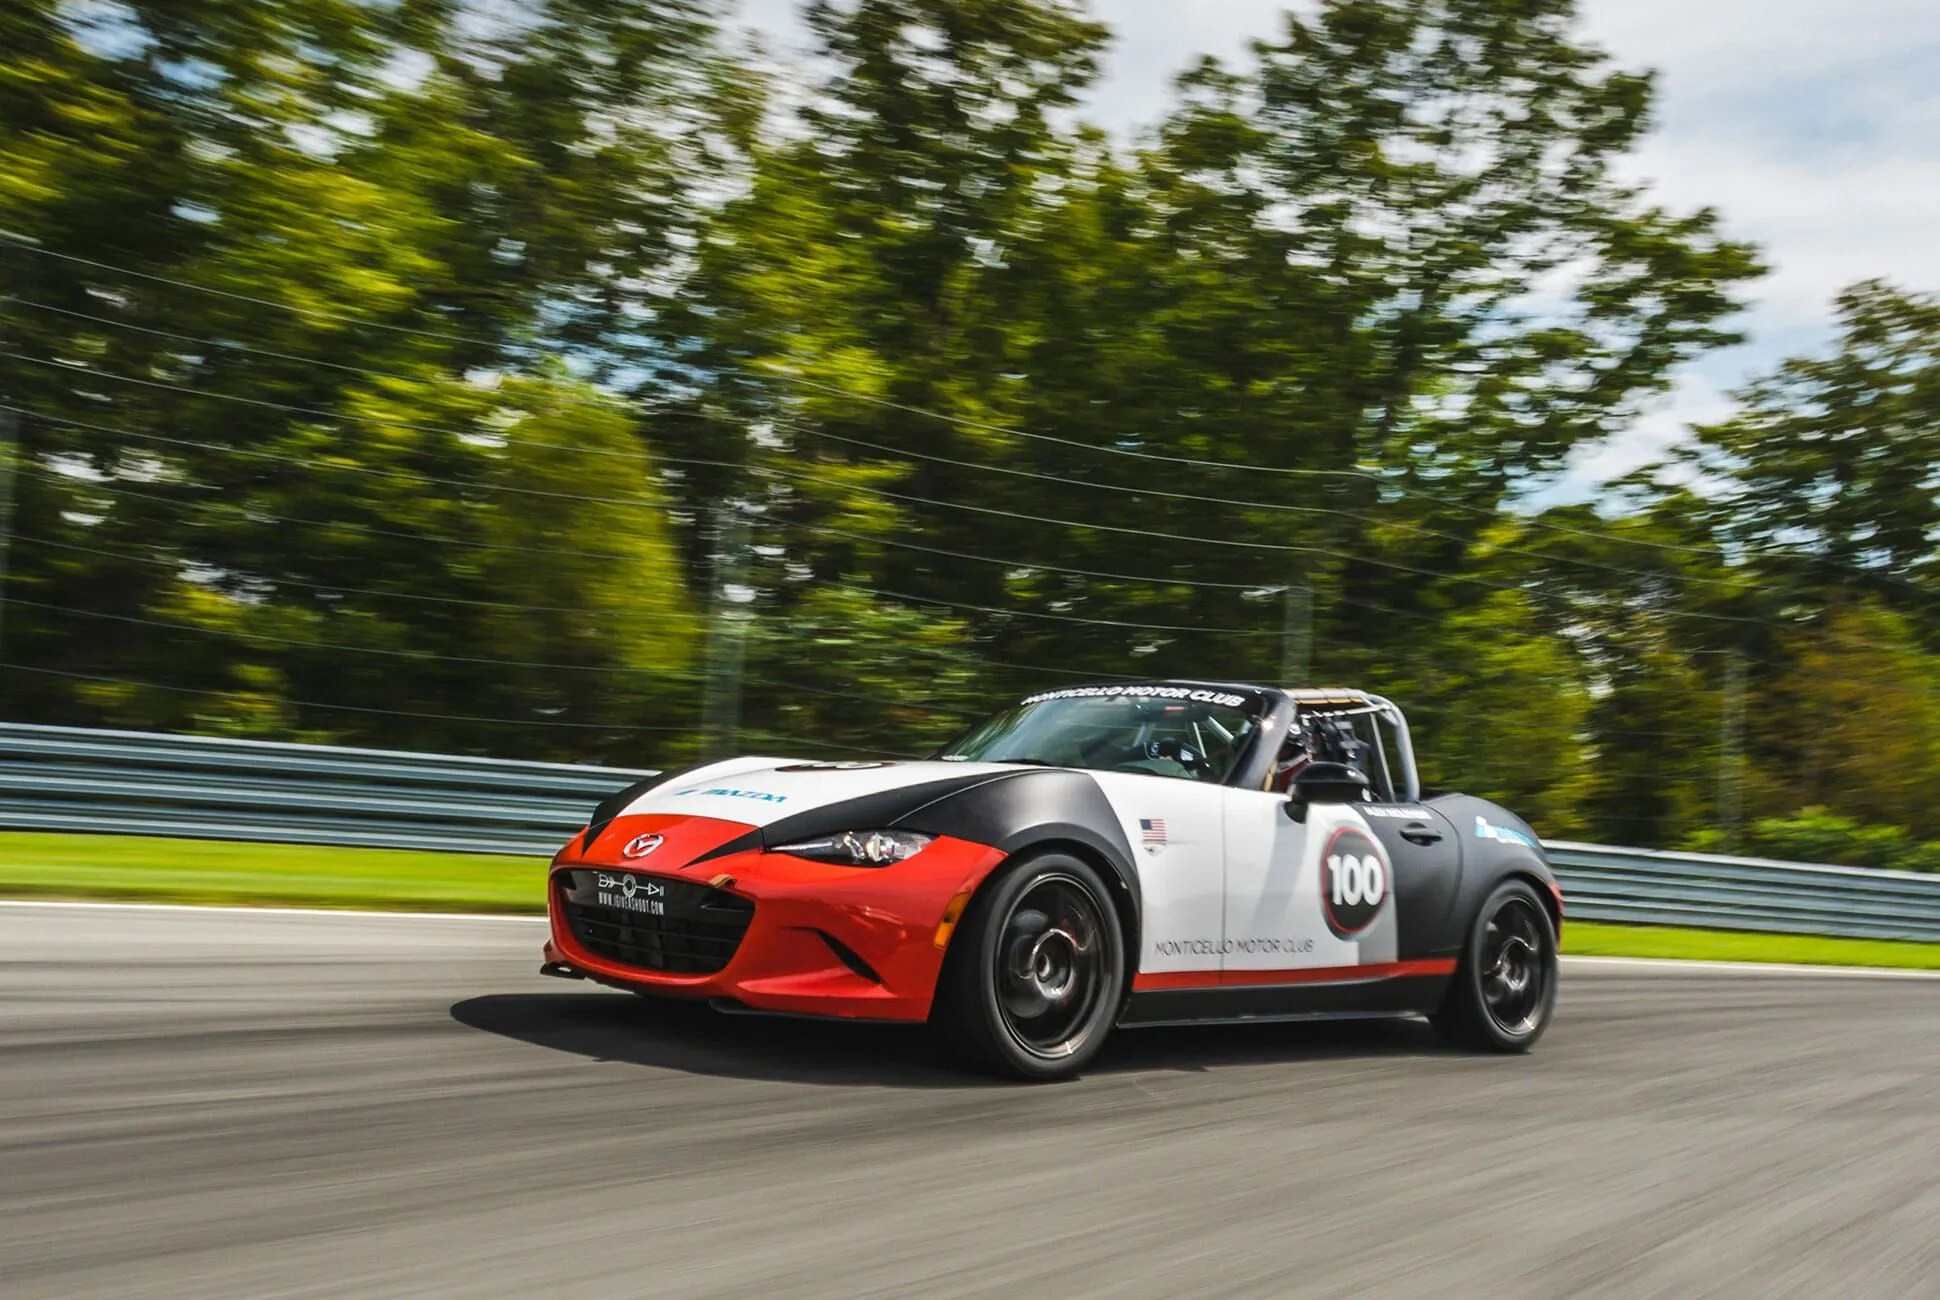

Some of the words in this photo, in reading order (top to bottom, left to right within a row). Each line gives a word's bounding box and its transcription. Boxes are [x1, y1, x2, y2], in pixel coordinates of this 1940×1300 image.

[1020, 686, 1123, 706] MONTICELLO
[1121, 686, 1190, 699] MOTOR
[1189, 690, 1246, 707] CLUB
[1326, 853, 1385, 906] 100
[1155, 938, 1233, 957] MONTICELLO
[1236, 936, 1281, 955] MOTOR
[1283, 936, 1315, 955] CLUB
